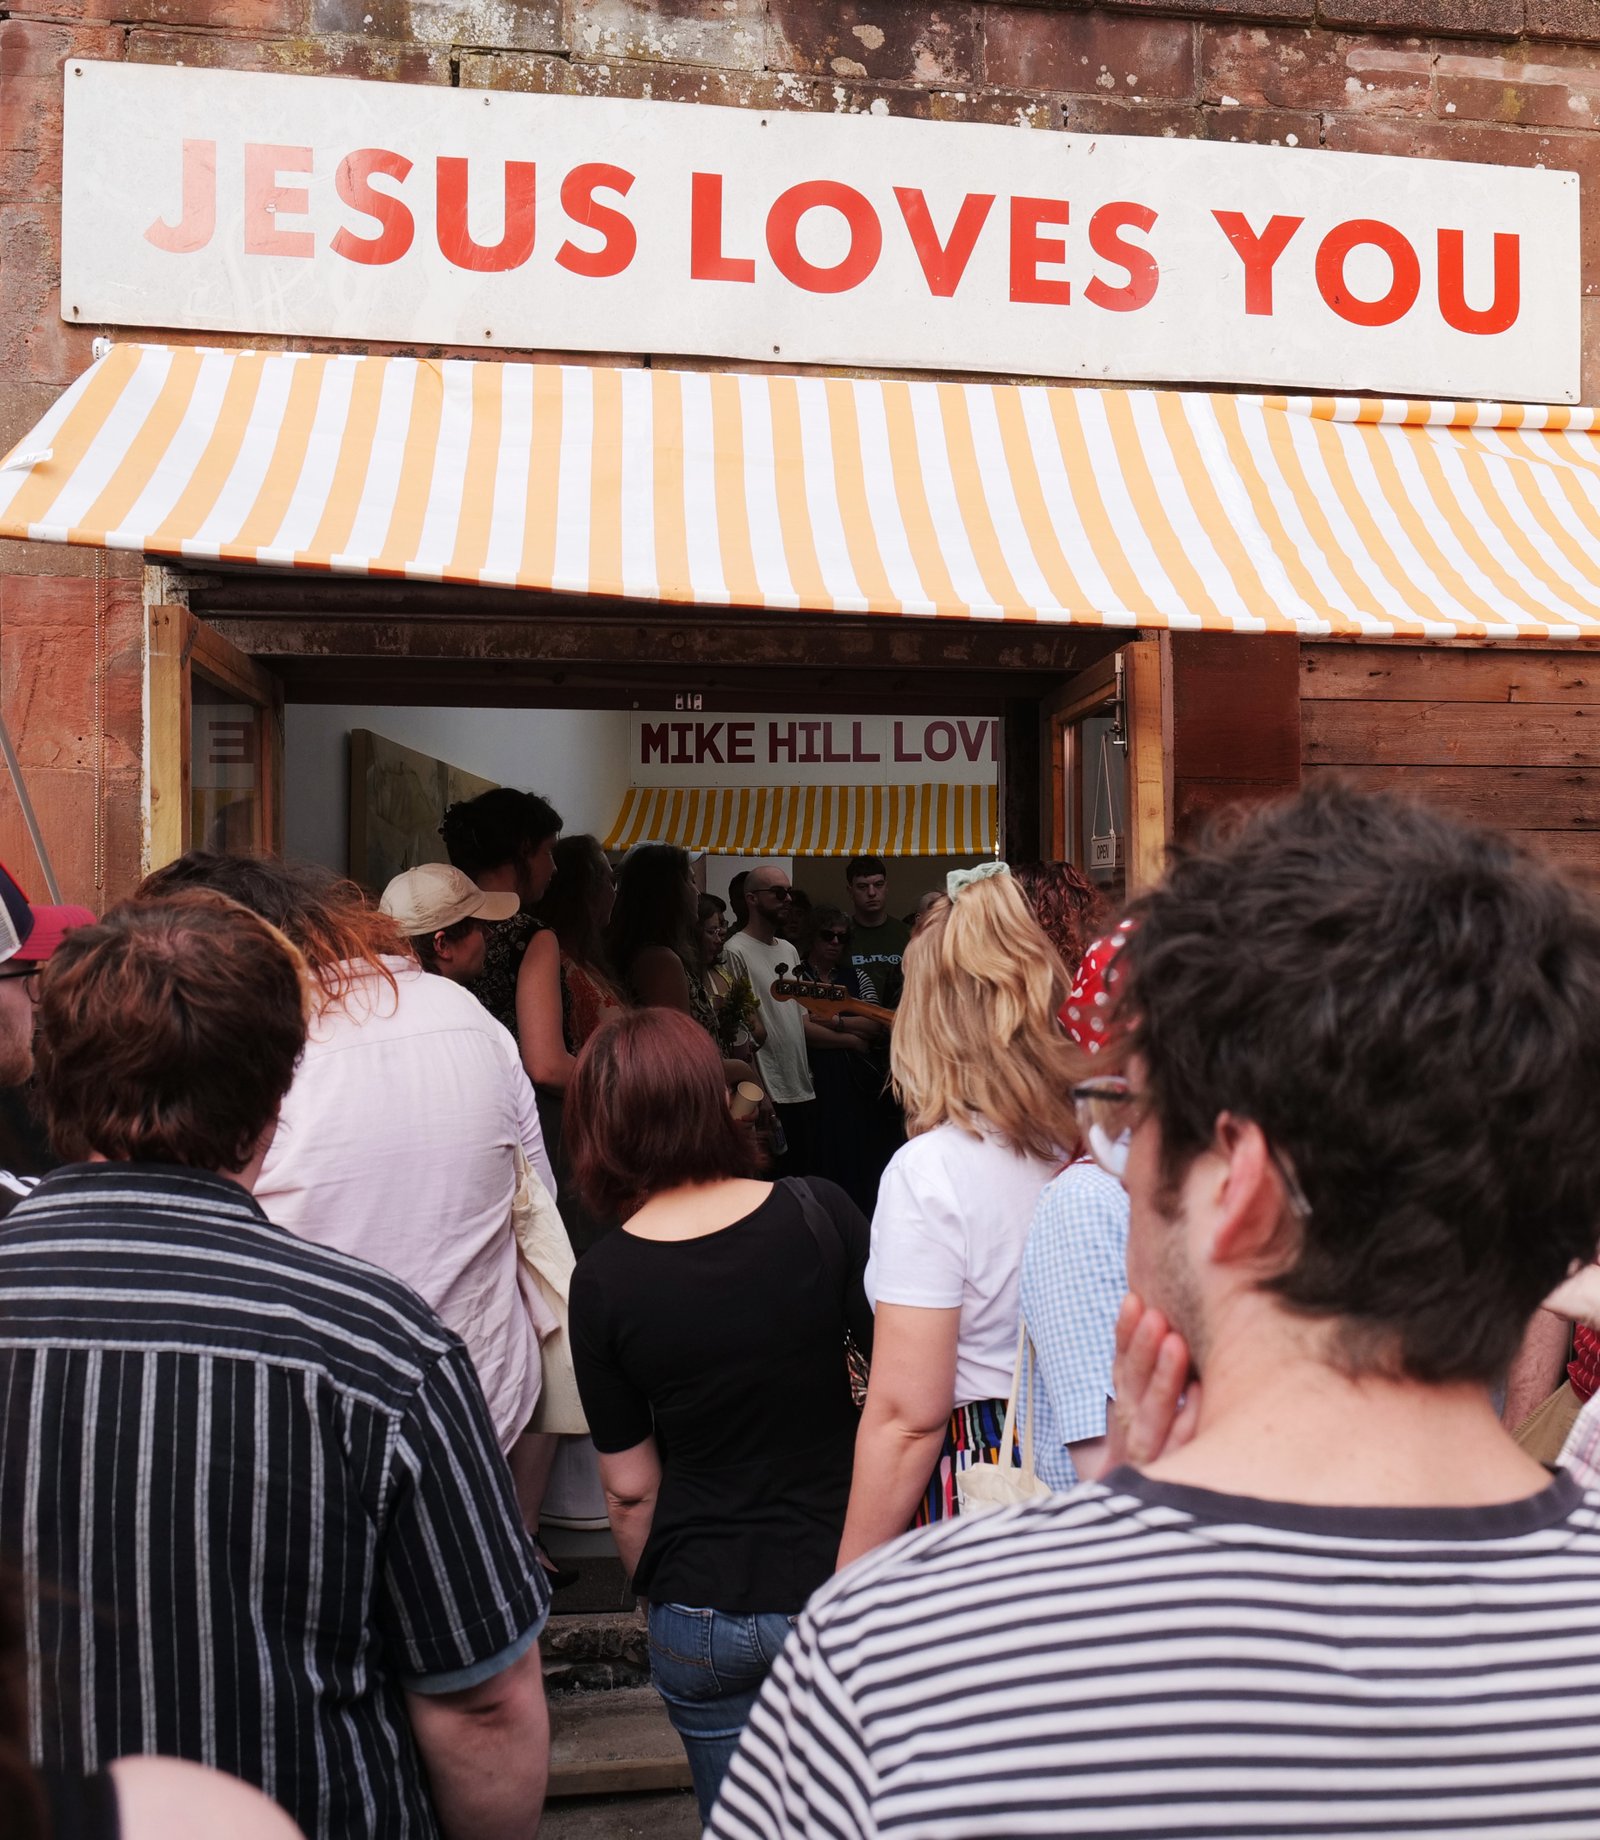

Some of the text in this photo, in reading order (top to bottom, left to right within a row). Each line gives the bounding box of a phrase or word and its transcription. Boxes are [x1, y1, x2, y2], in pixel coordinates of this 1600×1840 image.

[143, 139, 1520, 335] JESUS LOVES YOU
[641, 720, 999, 764] MIKE HILL LOV
[1096, 844, 1109, 860] OPEN
